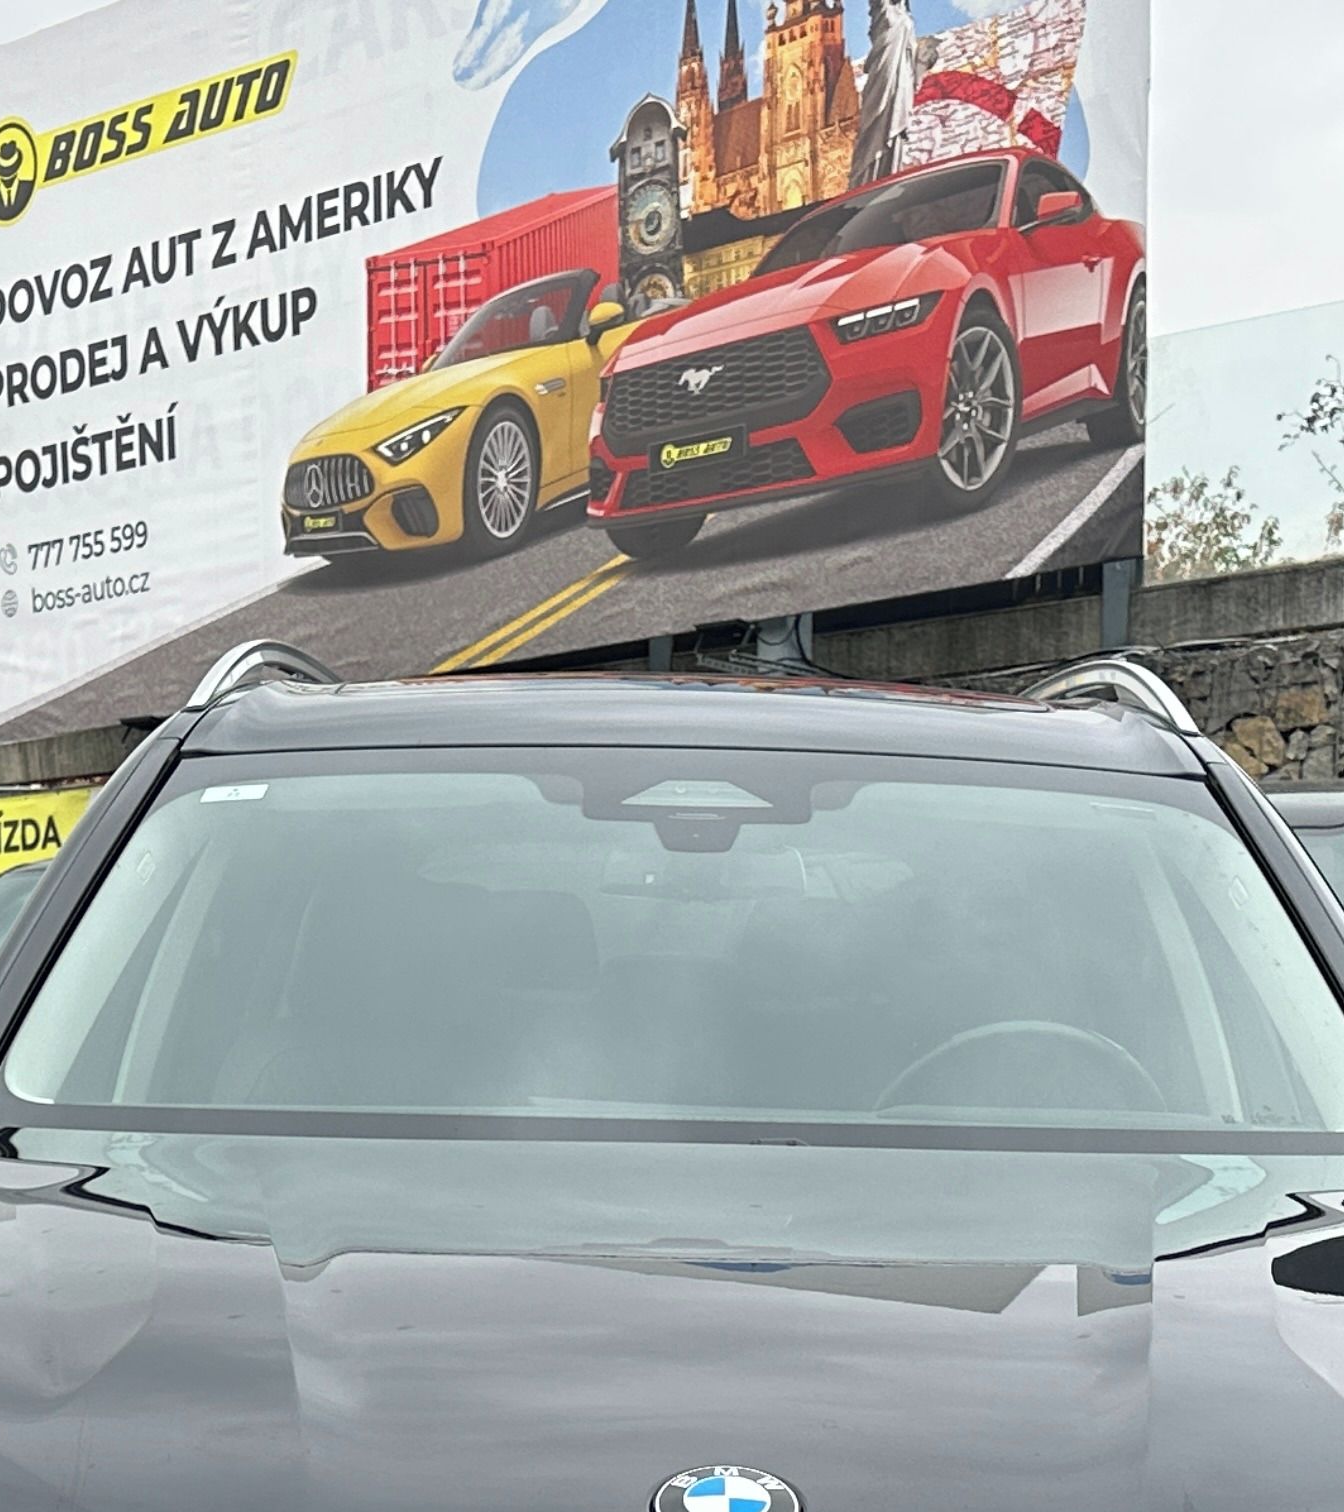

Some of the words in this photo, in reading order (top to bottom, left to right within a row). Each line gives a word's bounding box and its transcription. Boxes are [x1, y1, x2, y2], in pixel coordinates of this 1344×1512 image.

[43, 103, 154, 183] BOSS
[162, 58, 291, 145] AUTO
[121, 228, 202, 294] AUT
[211, 218, 237, 269] Z
[246, 155, 444, 260] AMERIKY
[139, 326, 170, 375] A
[176, 286, 318, 362] VÝKUP
[27, 537, 64, 571] 777
[69, 529, 106, 563] 755
[109, 520, 149, 553] 599
[31, 571, 151, 614] boss-auto.cz
[669, 1467, 786, 1490] BMW
